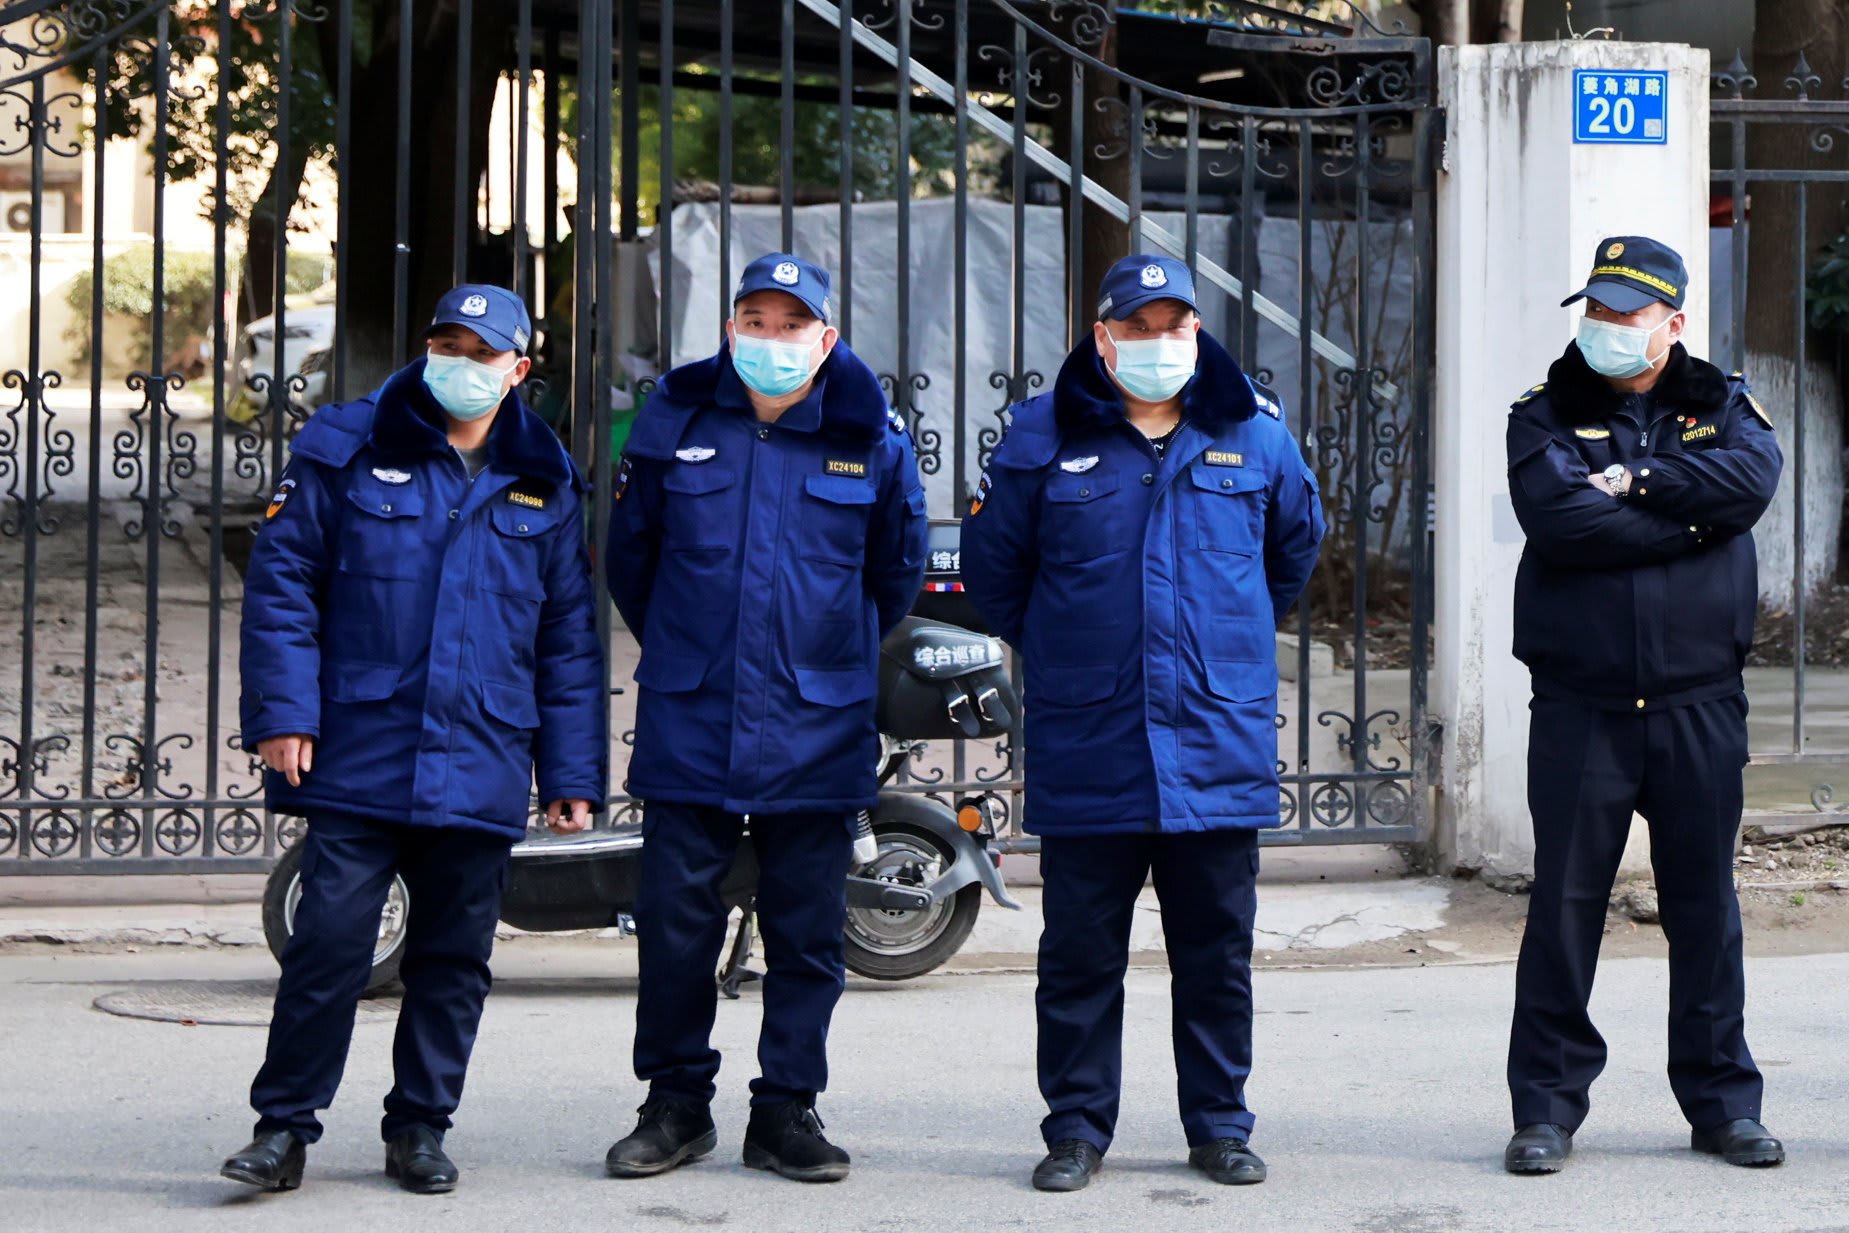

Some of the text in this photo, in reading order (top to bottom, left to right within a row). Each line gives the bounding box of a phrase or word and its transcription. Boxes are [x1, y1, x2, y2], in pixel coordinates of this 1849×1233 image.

[1588, 96, 1635, 135] 20
[828, 460, 864, 474] XC24104
[1207, 452, 1241, 464] XC24101
[914, 644, 986, 667] 综合巡查
